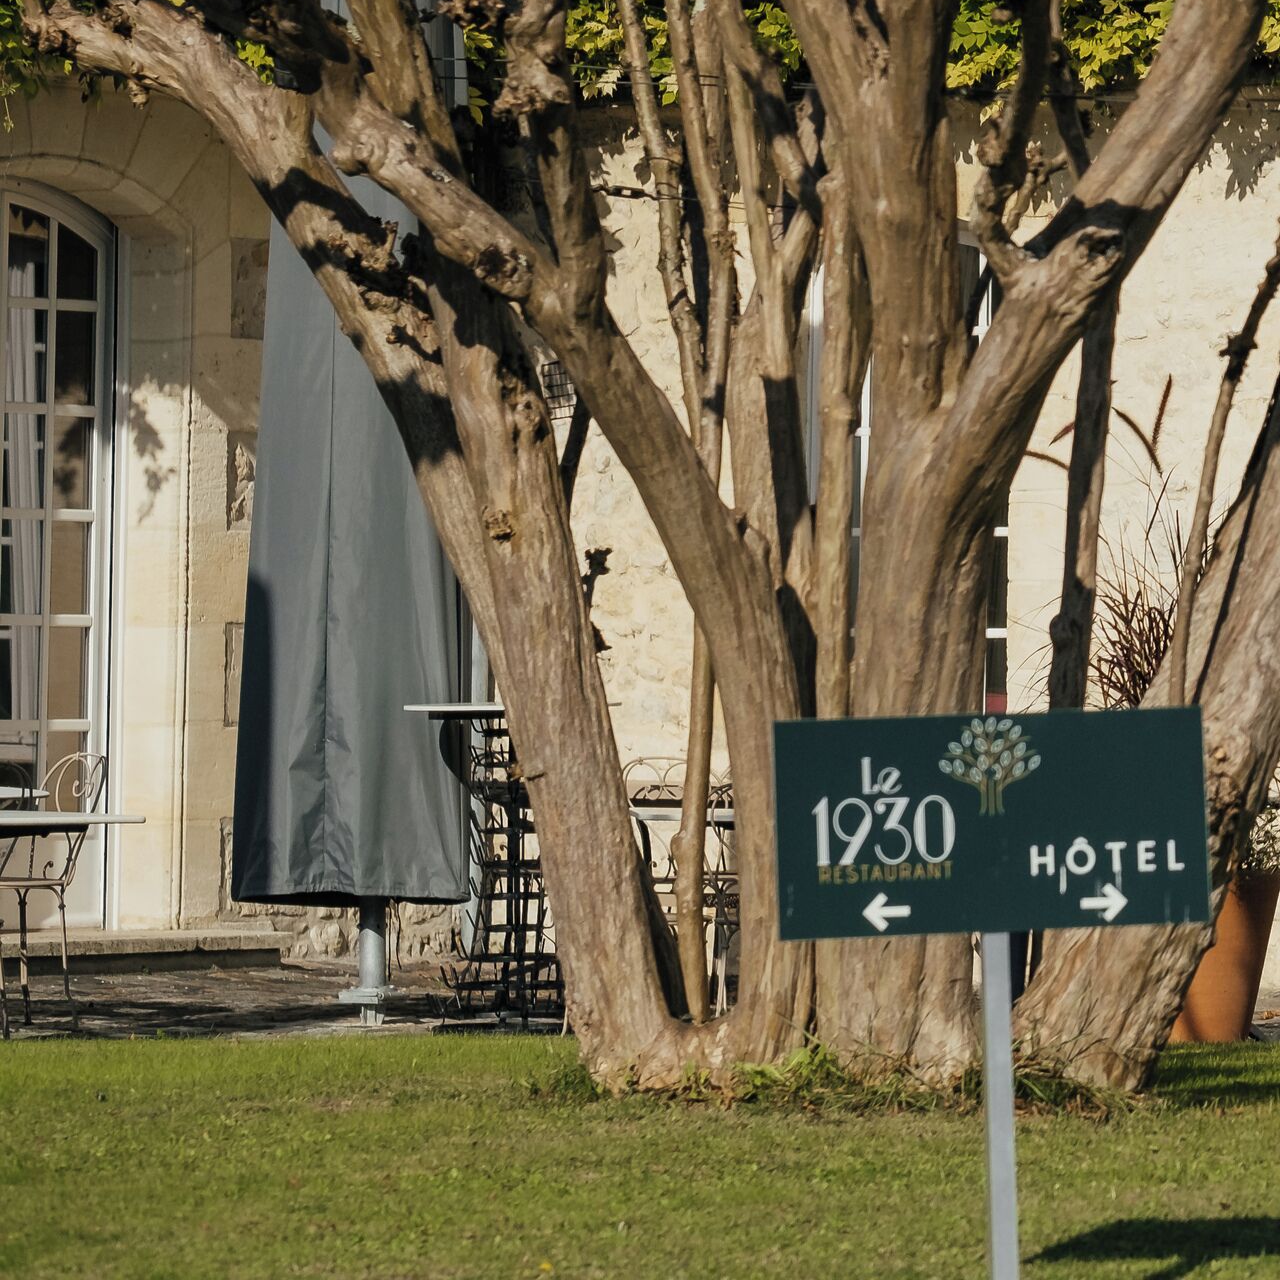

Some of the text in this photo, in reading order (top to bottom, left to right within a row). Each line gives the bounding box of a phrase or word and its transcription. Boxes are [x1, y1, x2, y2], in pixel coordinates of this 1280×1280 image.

[860, 756, 902, 796] Le
[811, 794, 956, 867] 1930
[817, 860, 953, 885] RESTAURANT
[1029, 836, 1186, 877] HÔTEL
